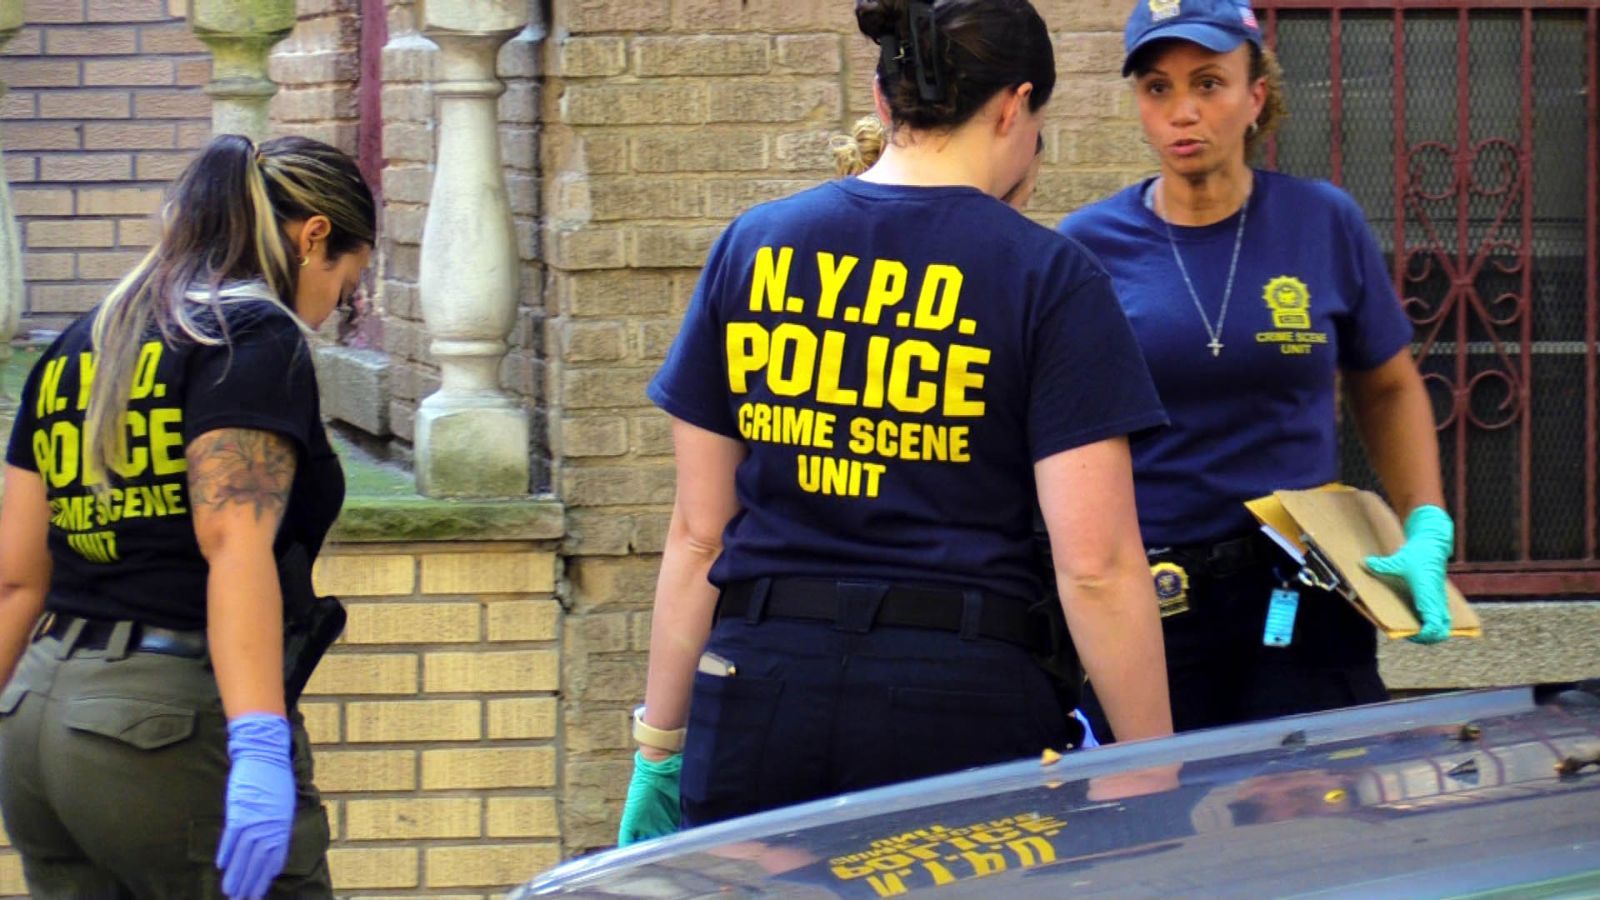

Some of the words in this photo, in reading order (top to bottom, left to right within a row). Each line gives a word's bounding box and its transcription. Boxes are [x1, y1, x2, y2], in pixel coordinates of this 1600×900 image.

[749, 246, 977, 336] N.Y.P.D.
[1256, 332, 1294, 343] CRIME
[1295, 332, 1328, 344] SCENE
[1280, 344, 1312, 355] UNIT
[726, 322, 991, 418] POLICE
[33, 408, 188, 488] POLCE
[738, 403, 836, 449] CRIME
[849, 417, 971, 463] SCENE
[797, 455, 887, 498] UNIT
